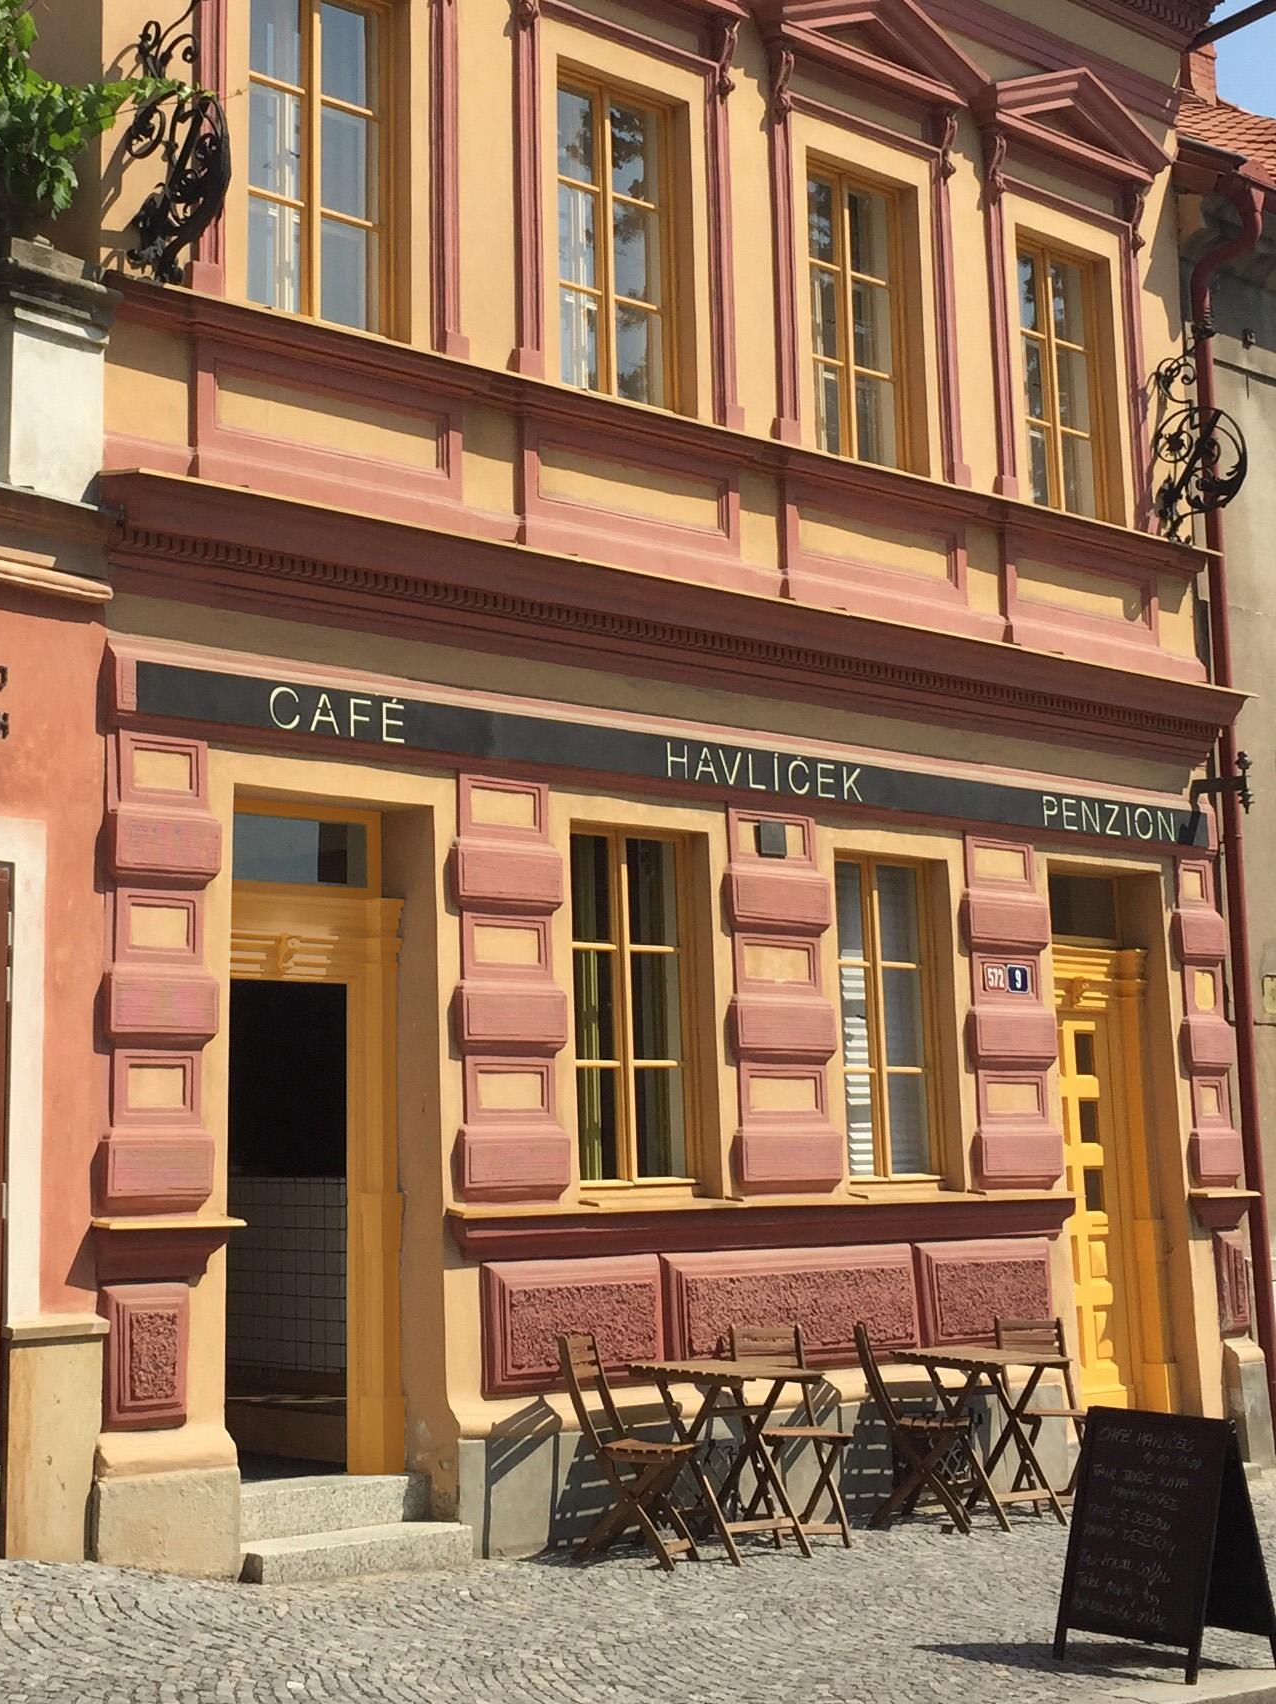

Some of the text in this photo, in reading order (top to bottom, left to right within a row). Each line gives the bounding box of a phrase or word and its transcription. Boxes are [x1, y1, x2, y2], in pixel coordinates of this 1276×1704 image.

[269, 686, 1176, 842] CAFÉ HAVLÍČEK PENZION
[987, 967, 1005, 988] 572
[1015, 969, 1022, 989] 9
